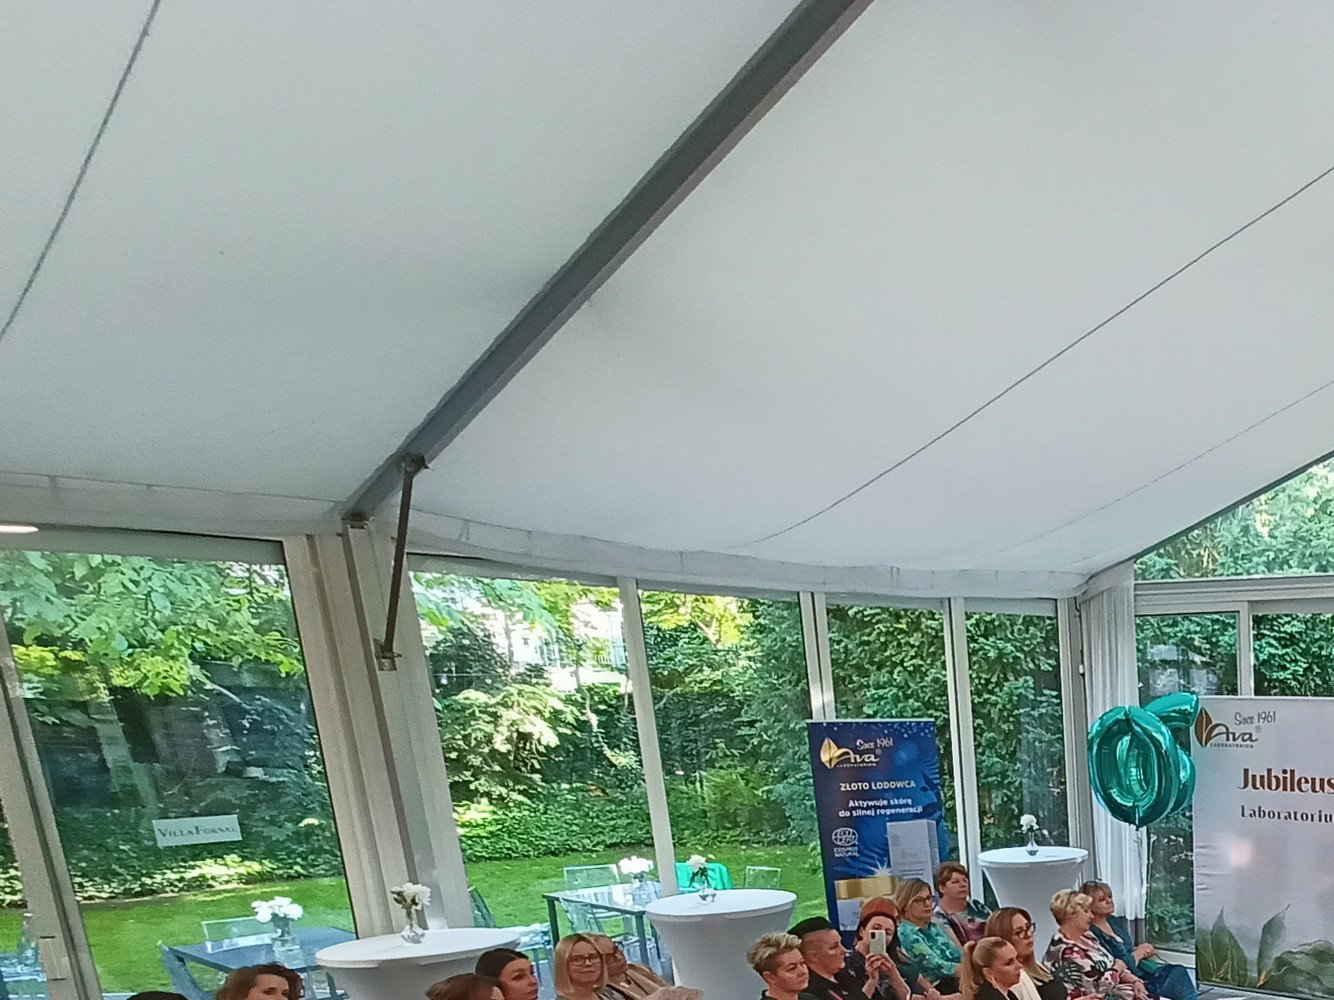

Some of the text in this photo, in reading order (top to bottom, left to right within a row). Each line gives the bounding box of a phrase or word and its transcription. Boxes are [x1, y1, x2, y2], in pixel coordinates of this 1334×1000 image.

[1234, 711, 1276, 725] Since 1961
[876, 737, 893, 748] 1961
[840, 780, 916, 791] ZŁOTO LODOWCA
[848, 798, 912, 808] Aktywuje skórę
[839, 806, 923, 817] do silnej regeneracji
